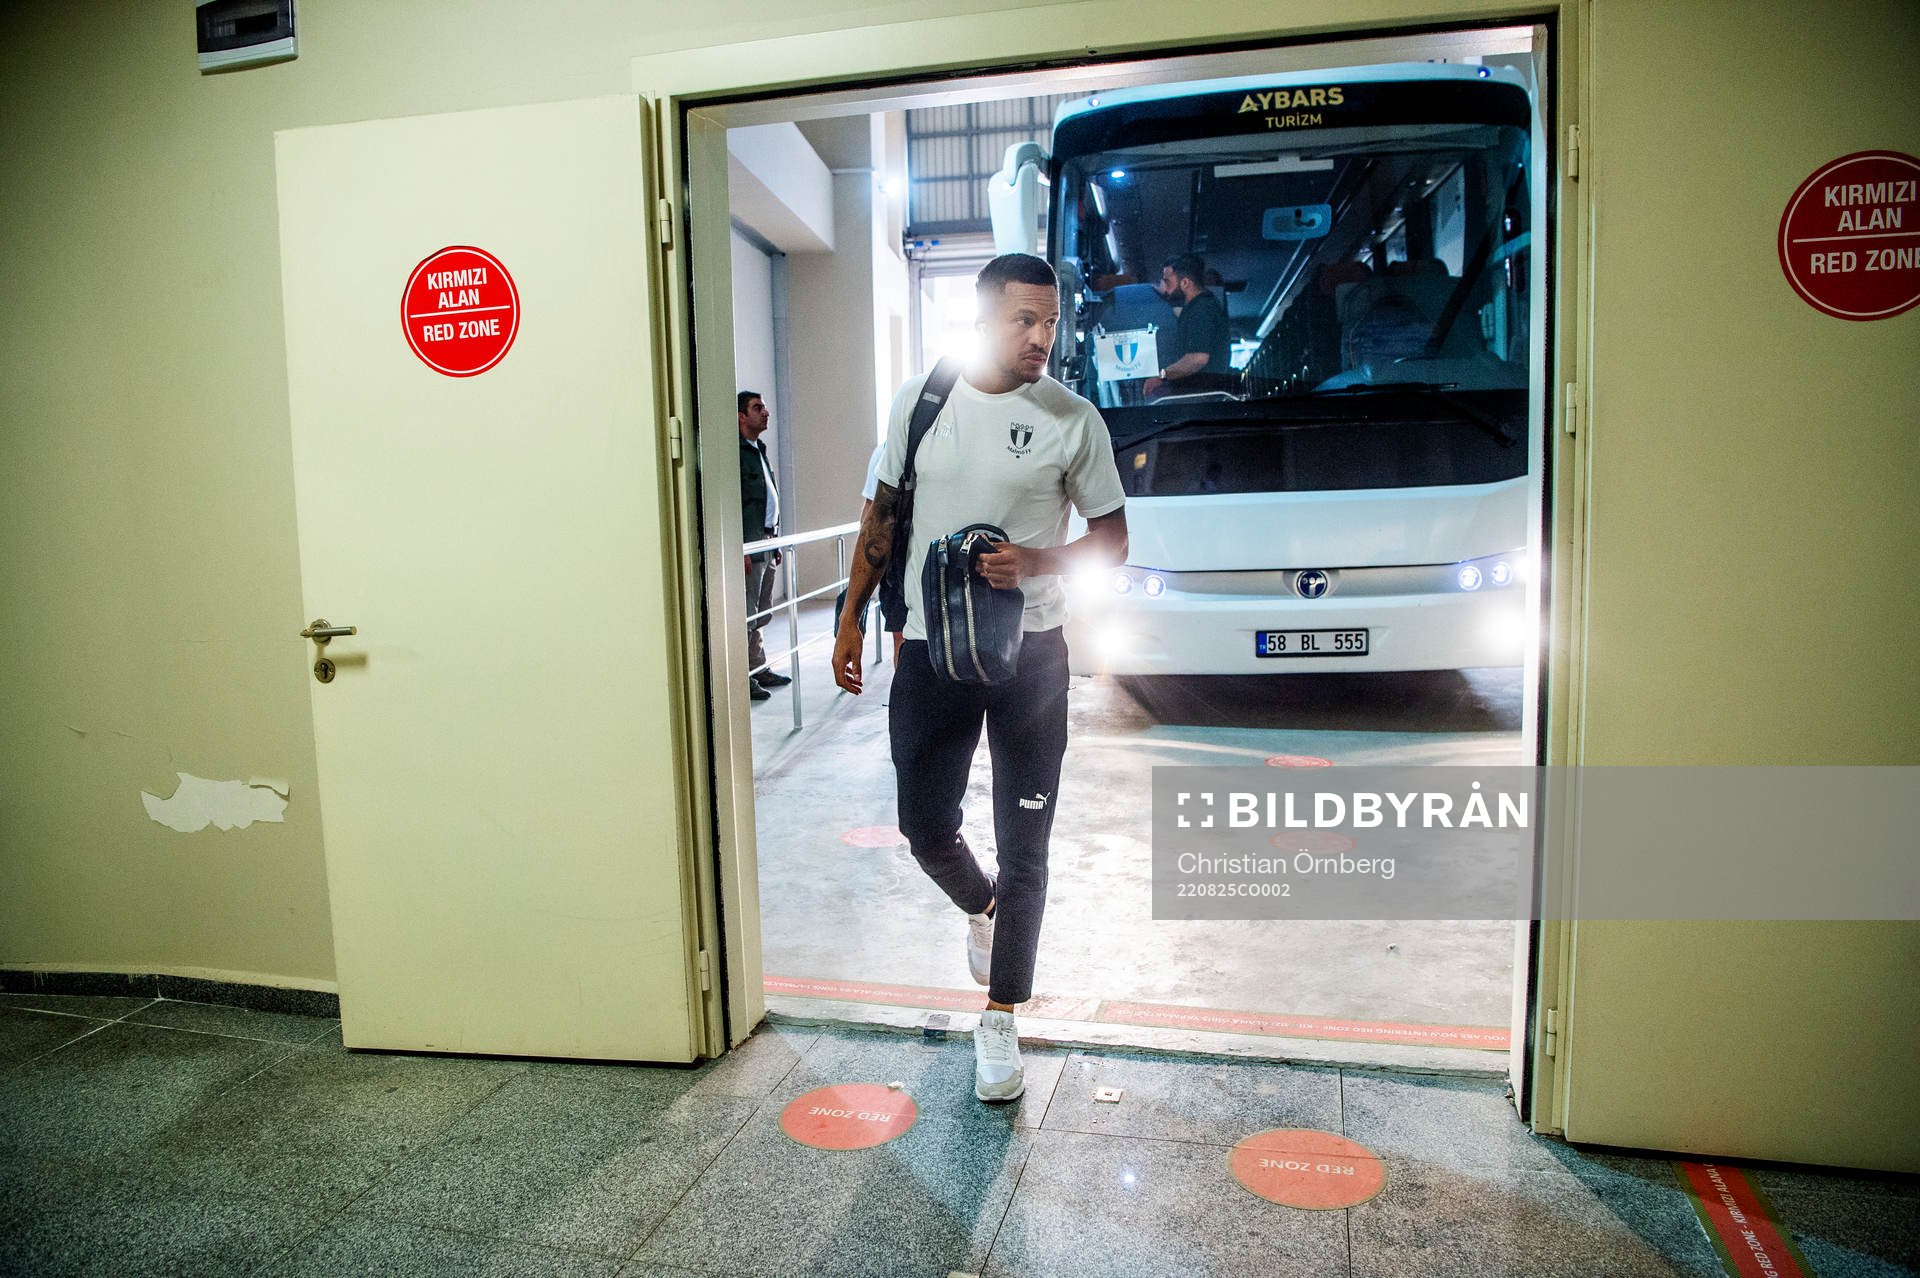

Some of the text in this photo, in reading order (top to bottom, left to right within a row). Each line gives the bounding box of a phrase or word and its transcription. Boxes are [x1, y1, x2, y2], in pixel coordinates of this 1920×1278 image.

[1237, 86, 1345, 114] AYBARS
[1265, 111, 1322, 129] TURİZM
[1824, 180, 1916, 208] KIRMIZI
[1837, 207, 1902, 232] ALAN
[1810, 251, 1857, 275] RED
[427, 267, 488, 290] KIRMIZI
[438, 288, 480, 309] ALAN
[423, 318, 501, 342] RED ZONE
[1268, 633, 1364, 651] 58 BL 555
[1019, 798, 1044, 810] PUMA
[808, 1106, 892, 1122] RED ZONE
[1258, 1158, 1355, 1175] RED ZONE
[1706, 1168, 1729, 1193] ALANA
[1720, 1193, 1747, 1224] KIRMIZI
[1741, 1229, 1764, 1251] ZONE
[1754, 1251, 1774, 1269] RED
